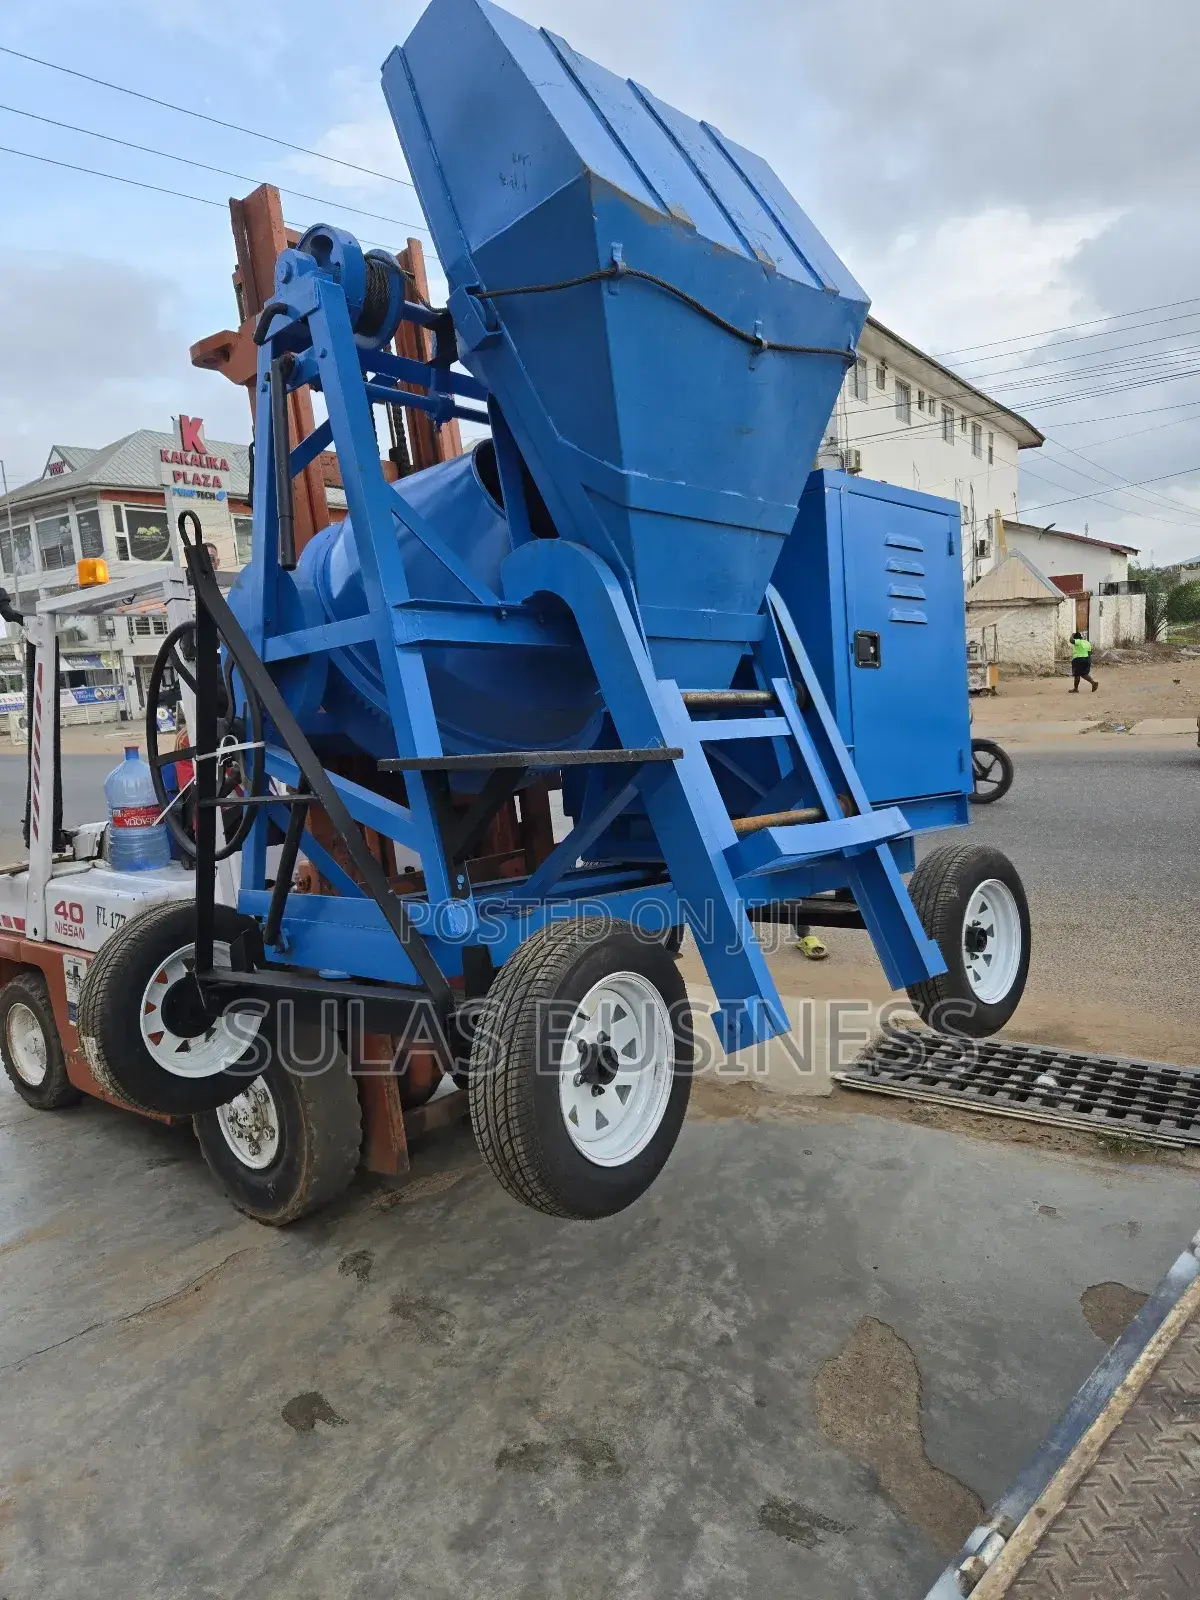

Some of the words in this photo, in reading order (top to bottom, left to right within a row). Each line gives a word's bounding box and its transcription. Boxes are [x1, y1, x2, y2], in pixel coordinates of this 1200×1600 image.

[179, 414, 207, 454] K
[160, 449, 229, 471] KAKALIKA
[172, 470, 222, 488] PLAZA
[54, 900, 84, 924] 40
[96, 905, 107, 927] FL
[54, 921, 85, 940] NISSAN
